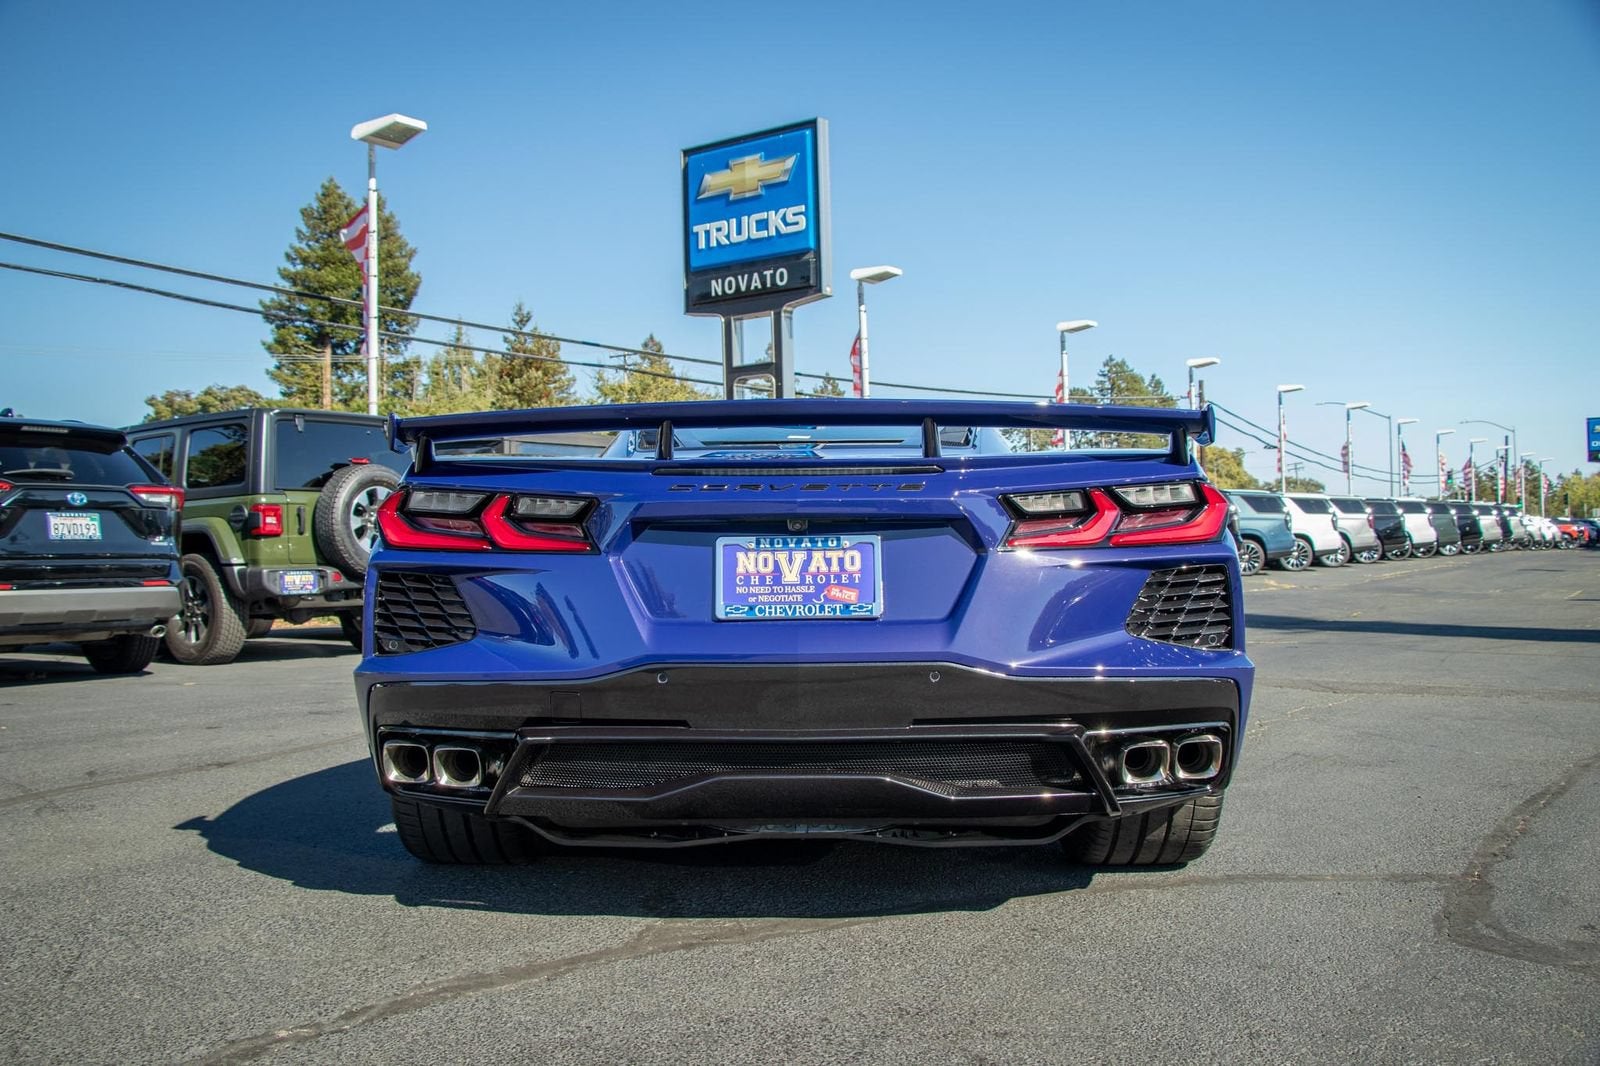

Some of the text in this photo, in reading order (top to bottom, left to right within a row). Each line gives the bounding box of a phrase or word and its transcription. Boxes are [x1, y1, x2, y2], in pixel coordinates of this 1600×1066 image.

[692, 204, 806, 250] TRUCKS
[710, 267, 788, 297] NOVATO
[667, 481, 926, 492] CORVETTE
[759, 536, 837, 548] NOVATO
[736, 549, 862, 584] NOVATO
[736, 586, 748, 594] NO
[749, 586, 771, 594] NEED
[785, 585, 815, 593] HASSLE
[758, 594, 803, 603] NEGOTIATE
[830, 590, 857, 602] PRICE
[755, 604, 843, 617] CHEVROLET
